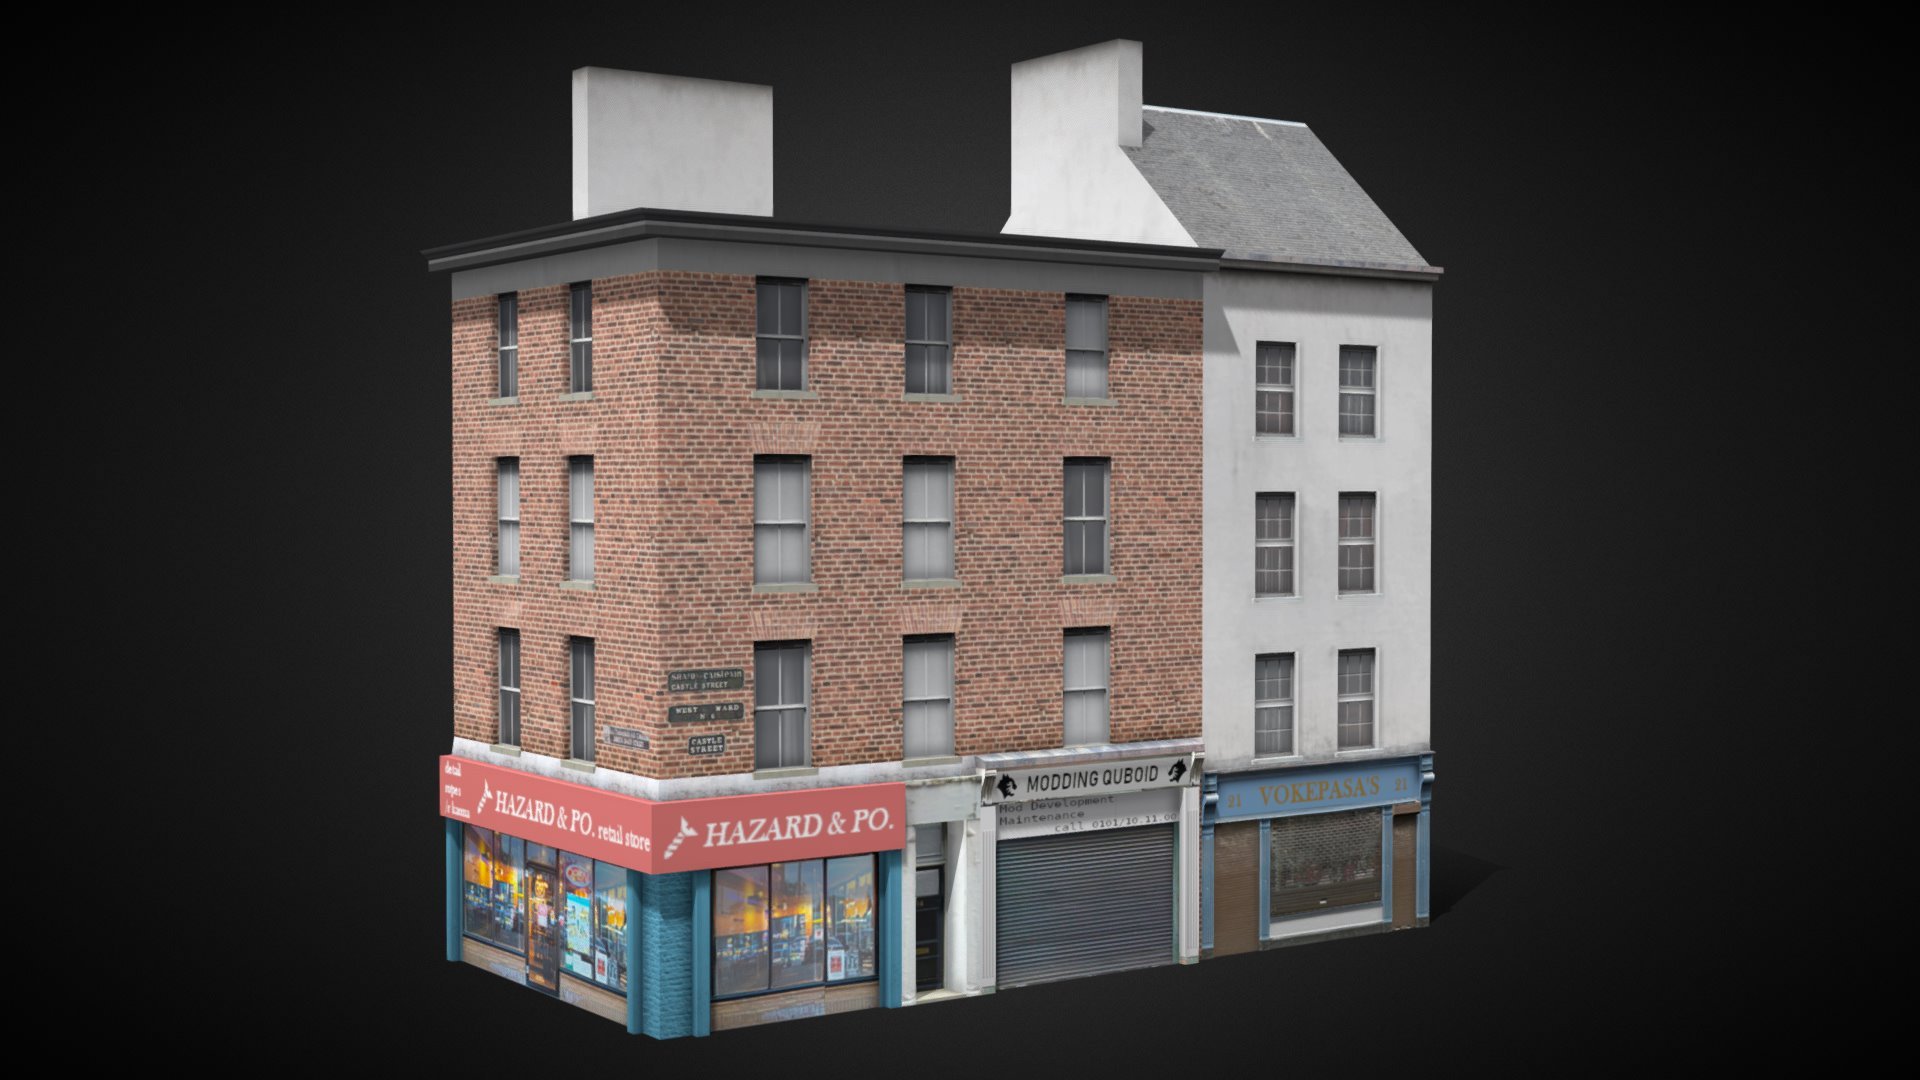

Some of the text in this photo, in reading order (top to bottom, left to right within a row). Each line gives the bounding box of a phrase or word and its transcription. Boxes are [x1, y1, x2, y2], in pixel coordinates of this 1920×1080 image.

[671, 681, 728, 690] CASTLE STREET
[675, 704, 739, 714] WEST WARD
[690, 744, 724, 753] STREET
[691, 737, 723, 746] CASTLE
[1026, 765, 1159, 793] MODDING QUBOID
[1258, 775, 1380, 807] VOKEPASA'S
[999, 795, 1115, 814] Mod Development
[495, 789, 651, 852] HAZARD & PO. retail store
[999, 810, 1085, 826] Maintenance
[702, 807, 895, 849] HAZARD & PO.
[1055, 822, 1084, 833] call
